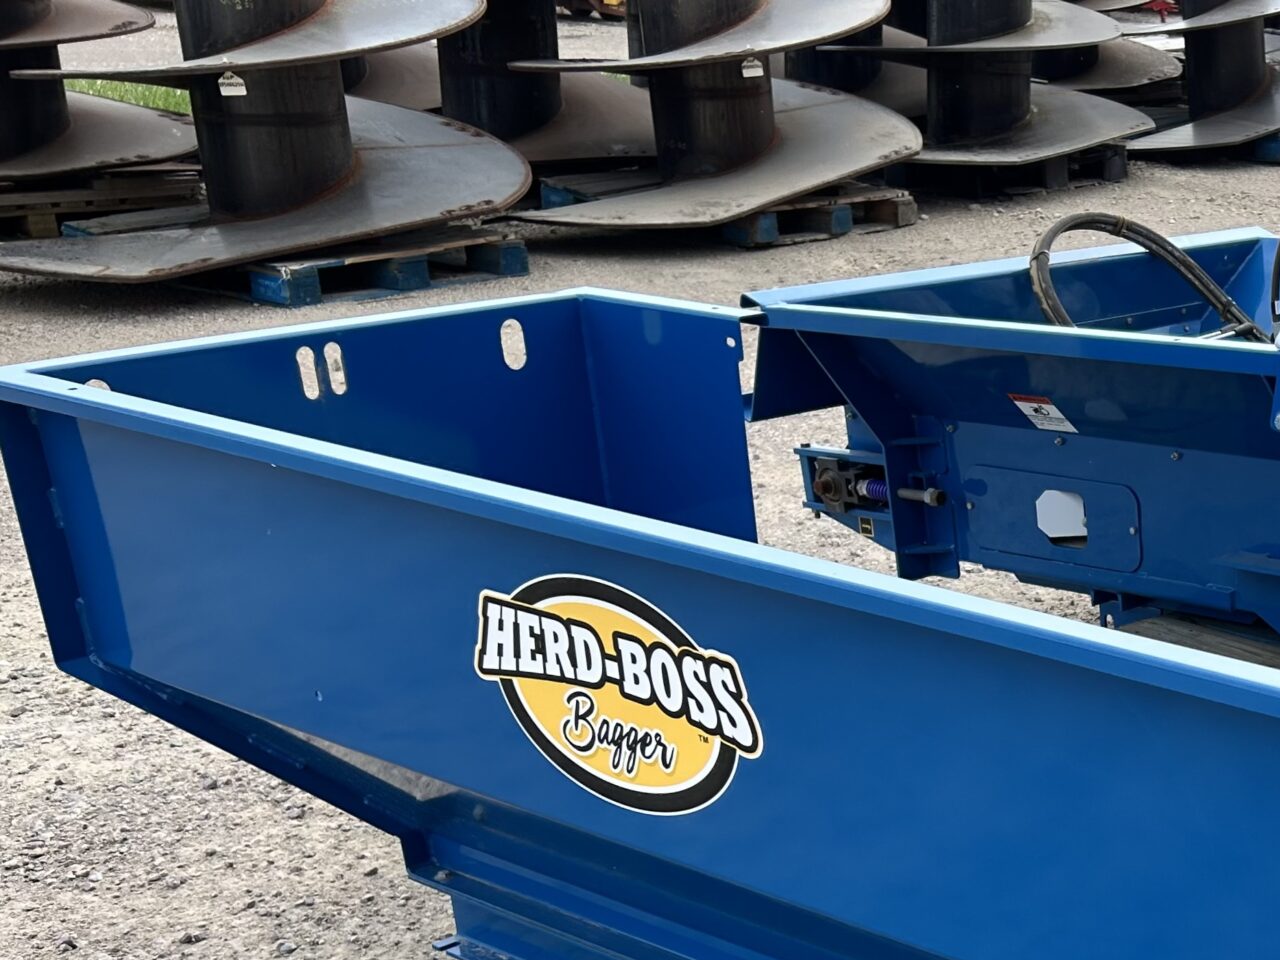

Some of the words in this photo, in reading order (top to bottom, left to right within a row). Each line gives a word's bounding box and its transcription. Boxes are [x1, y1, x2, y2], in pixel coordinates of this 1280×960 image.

[481, 600, 754, 749] HERD-BOSS
[562, 690, 675, 775] Bagger
[697, 733, 710, 744] TM
